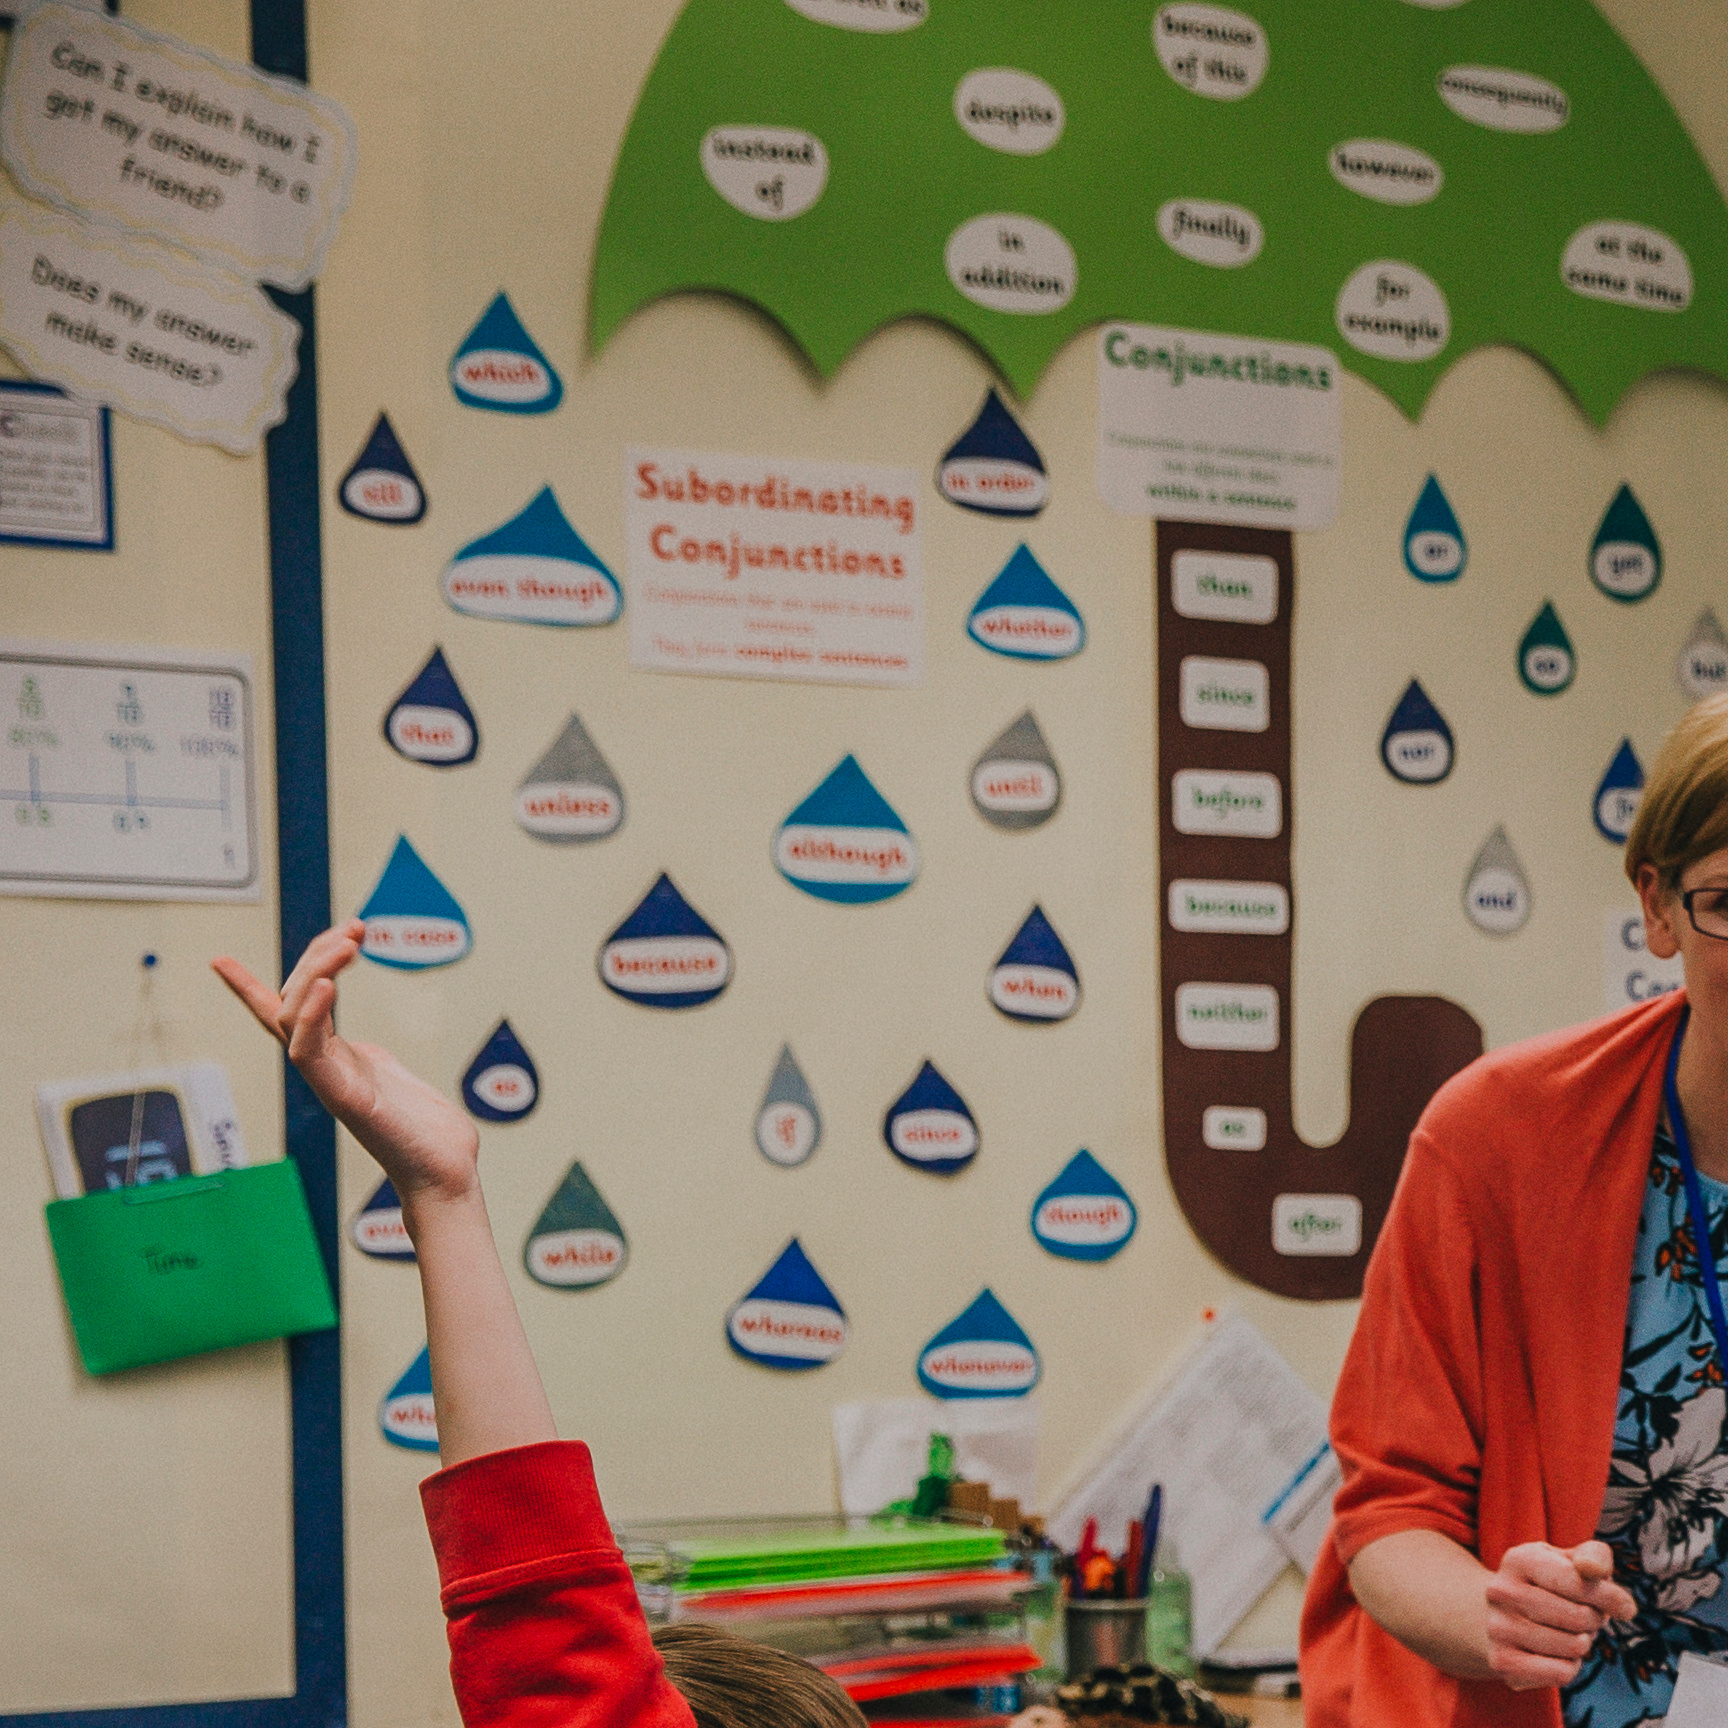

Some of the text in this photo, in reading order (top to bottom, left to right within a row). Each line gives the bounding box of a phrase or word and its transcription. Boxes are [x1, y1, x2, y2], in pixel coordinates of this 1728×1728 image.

[50, 42, 322, 167] Can I explain how I
[102, 109, 142, 150] my
[147, 119, 245, 177] answer
[254, 163, 286, 196] to
[289, 180, 312, 205] a
[712, 131, 815, 166] instead
[1336, 151, 1435, 185] however
[118, 157, 227, 213] friend?
[755, 177, 784, 211] of
[999, 231, 1025, 252] in
[1171, 205, 1253, 253] finally
[962, 266, 1067, 297] addition
[1374, 272, 1411, 308] for
[31, 254, 258, 359] Does my answer
[44, 310, 227, 391] make sense?
[1344, 310, 1443, 348] example
[463, 356, 540, 386] which
[1103, 329, 1333, 391] Conjunctions
[635, 460, 916, 536] Subordinating
[649, 523, 908, 581] Conjunctions
[788, 840, 908, 876] although
